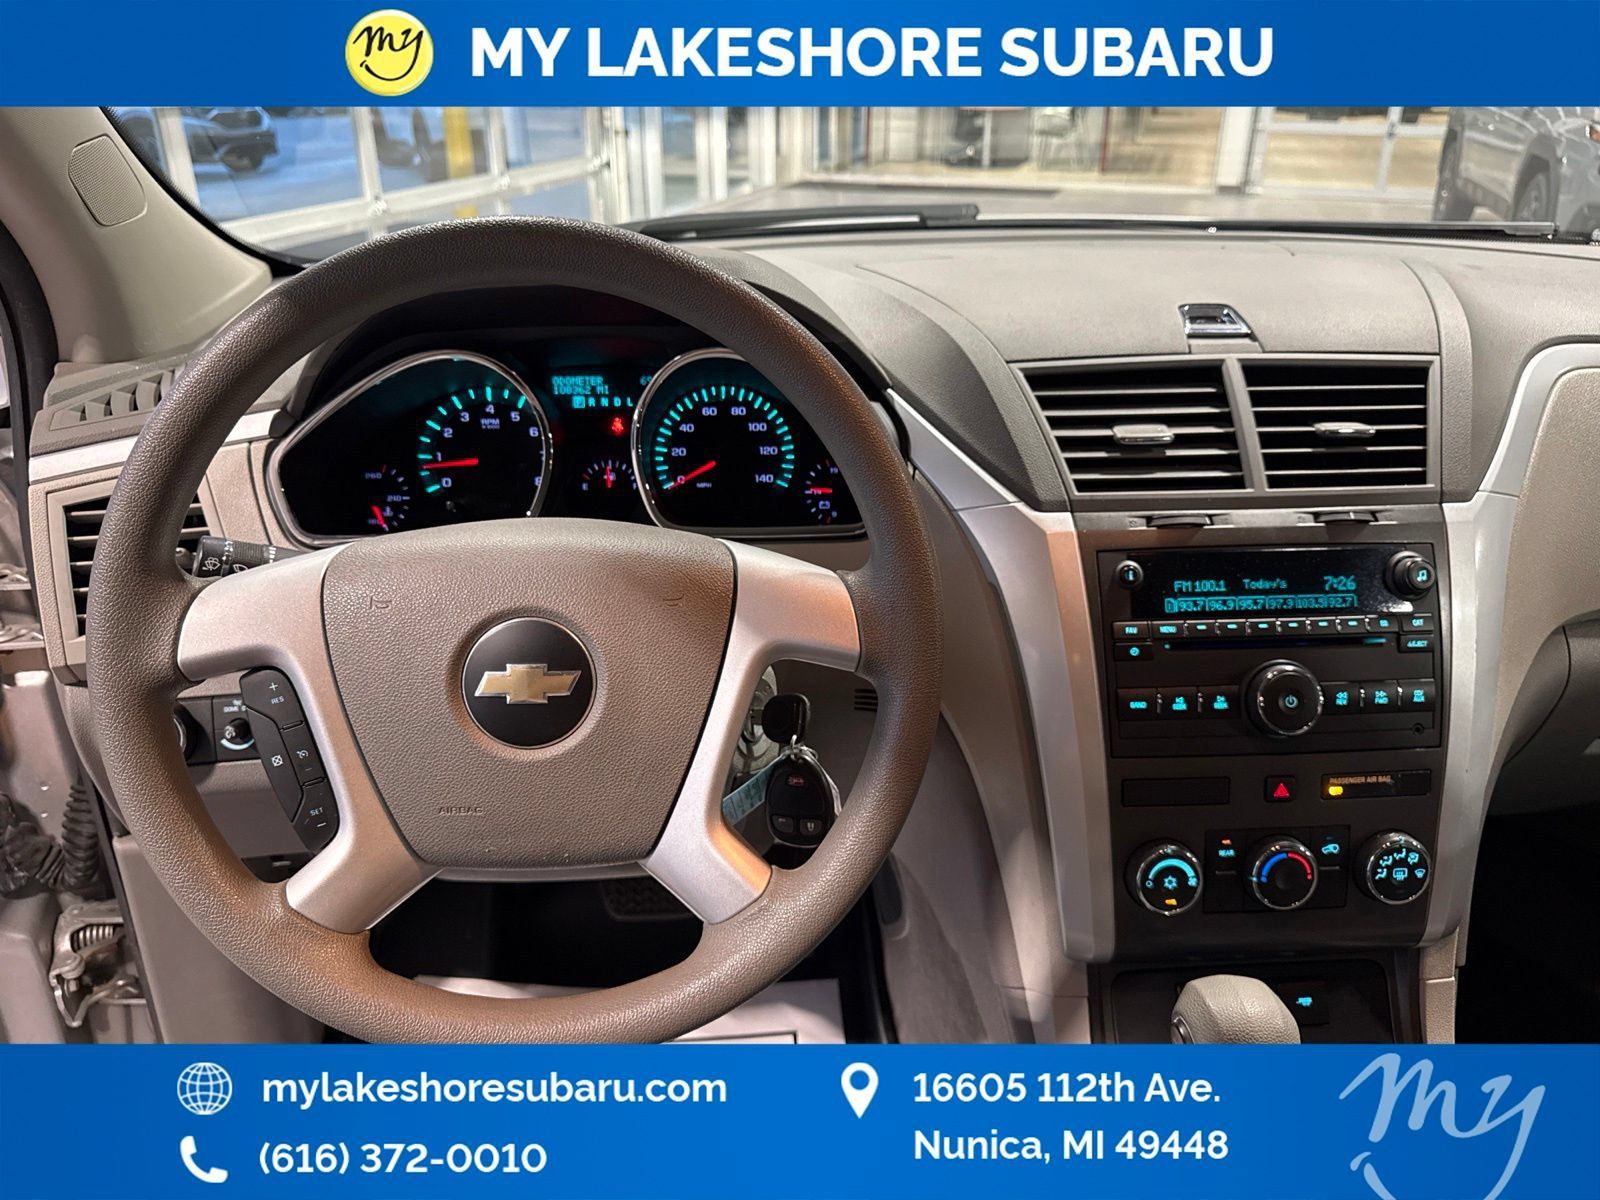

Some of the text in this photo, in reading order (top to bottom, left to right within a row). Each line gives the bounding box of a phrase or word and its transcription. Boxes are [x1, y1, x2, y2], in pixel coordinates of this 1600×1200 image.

[552, 376, 603, 386] ODOMETER
[601, 397, 609, 407] N
[613, 397, 622, 407] D
[626, 397, 634, 407] L
[485, 404, 495, 414] 4
[701, 406, 718, 417] 60
[730, 406, 747, 417] 80
[460, 411, 470, 422] 3
[510, 411, 521, 422] 5
[529, 426, 539, 437] 6
[679, 423, 695, 433] 40
[748, 422, 768, 432] 100
[443, 427, 453, 438] 2
[671, 447, 687, 457] 20
[759, 446, 778, 456] 120
[442, 477, 452, 488] 0
[754, 474, 774, 484] 140
[1242, 578, 1288, 589] Today's
[1323, 575, 1357, 590] 7:26
[1178, 601, 1204, 612] 93.7
[1125, 626, 1138, 634] FAV
[271, 696, 285, 705] RES
[1329, 776, 1366, 785] PASSENGER
[1366, 775, 1378, 783] AIR
[310, 807, 324, 817] SET
[439, 806, 483, 816] AIRBAG
[1218, 849, 1235, 858] REAR
